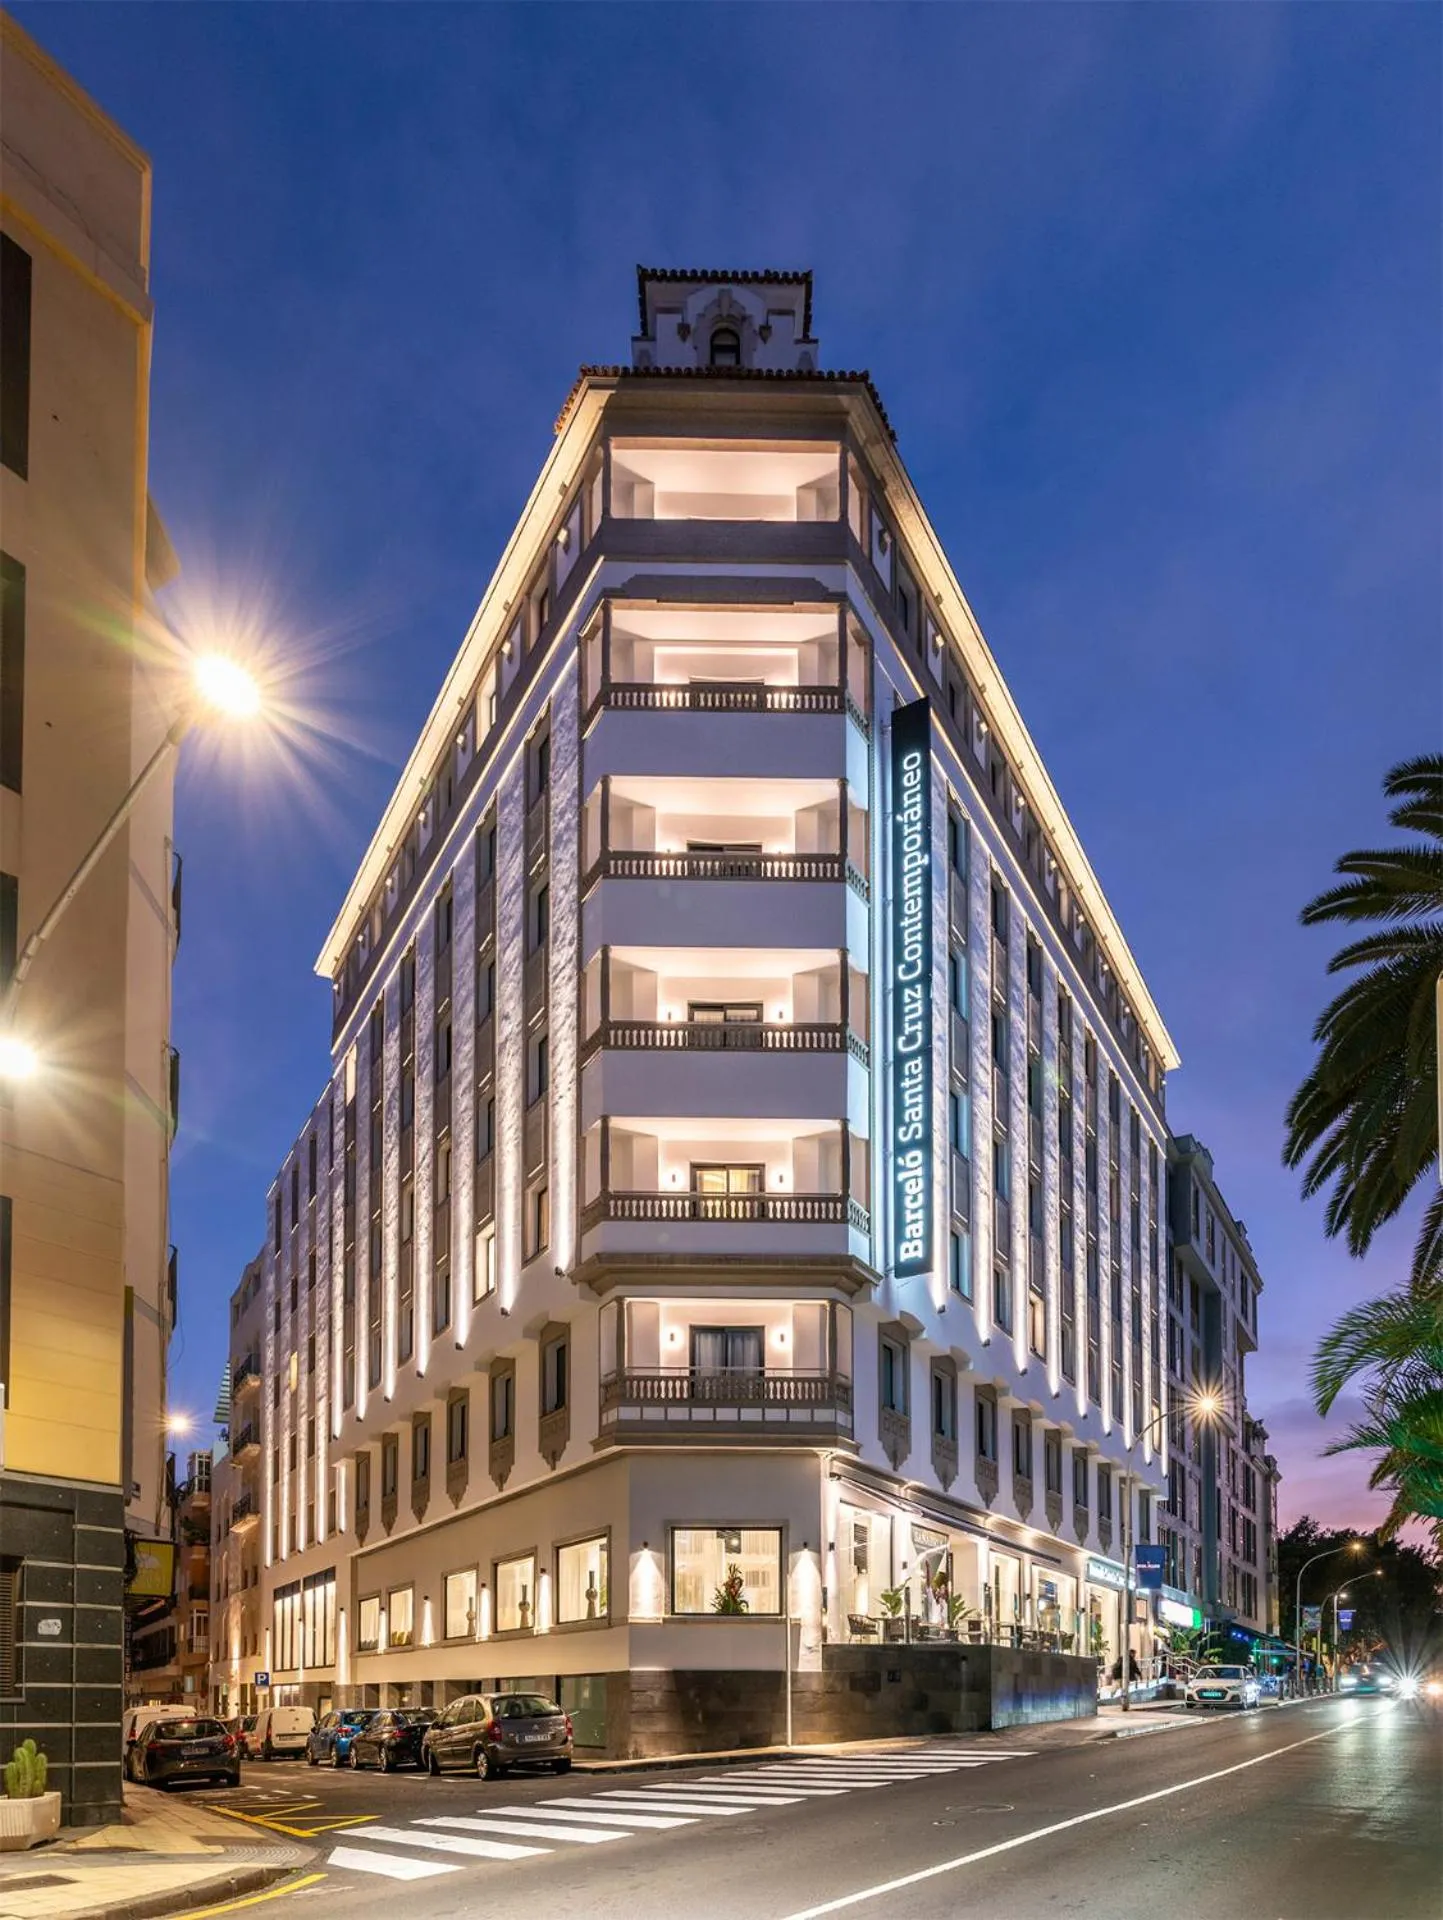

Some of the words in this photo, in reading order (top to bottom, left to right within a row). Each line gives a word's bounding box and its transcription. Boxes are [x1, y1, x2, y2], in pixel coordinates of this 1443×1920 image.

[896, 751, 929, 981] Contemporáneo
[898, 984, 922, 1053] Cruz
[899, 1056, 923, 1143] Santa
[897, 1150, 923, 1261] Barceló
[257, 1673, 266, 1684] P
